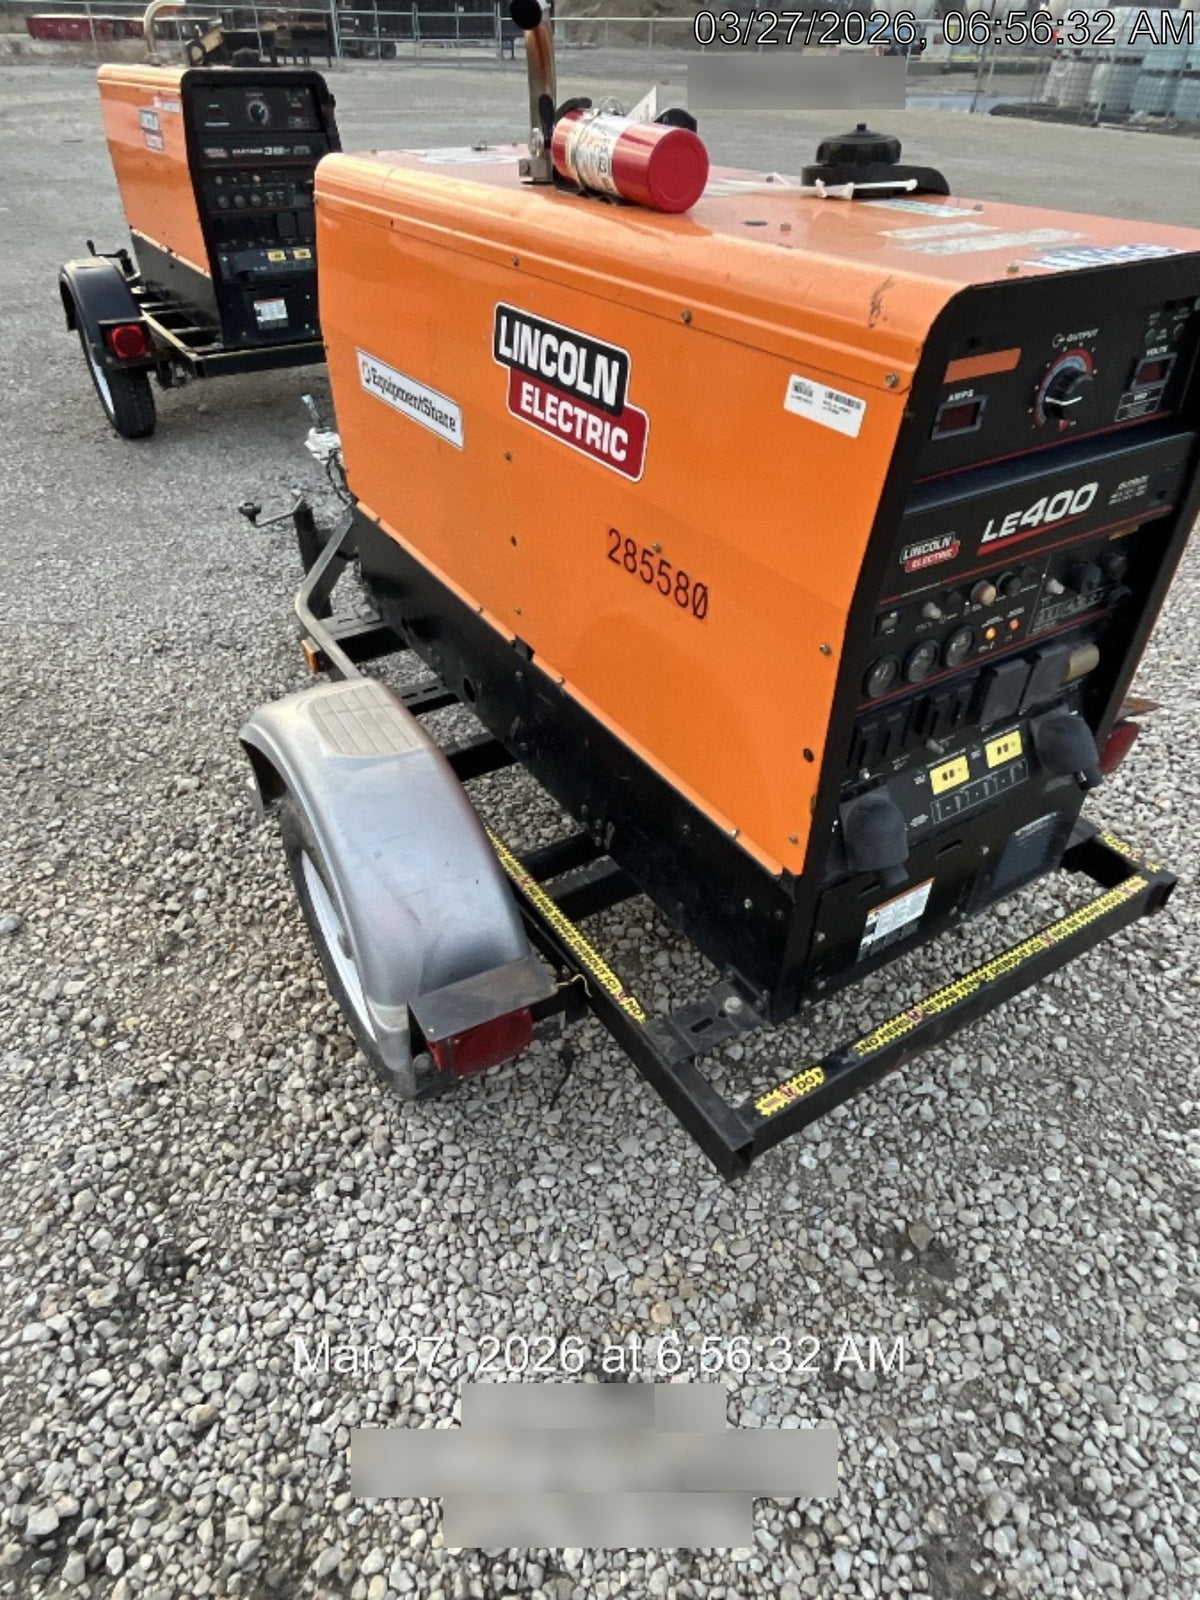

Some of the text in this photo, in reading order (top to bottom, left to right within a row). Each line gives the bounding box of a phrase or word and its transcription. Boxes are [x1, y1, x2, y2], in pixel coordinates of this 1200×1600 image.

[499, 316, 619, 406] LINCOLN
[1067, 329, 1099, 343] OUTPUT
[371, 366, 456, 433] EquipmentShare
[520, 381, 628, 462] ELECTRIC
[948, 389, 974, 401] AMPS
[980, 481, 1098, 543] LE400
[608, 528, 708, 620] 285580
[903, 536, 953, 561] LINCOLN
[912, 549, 953, 569] ELECTRIC
